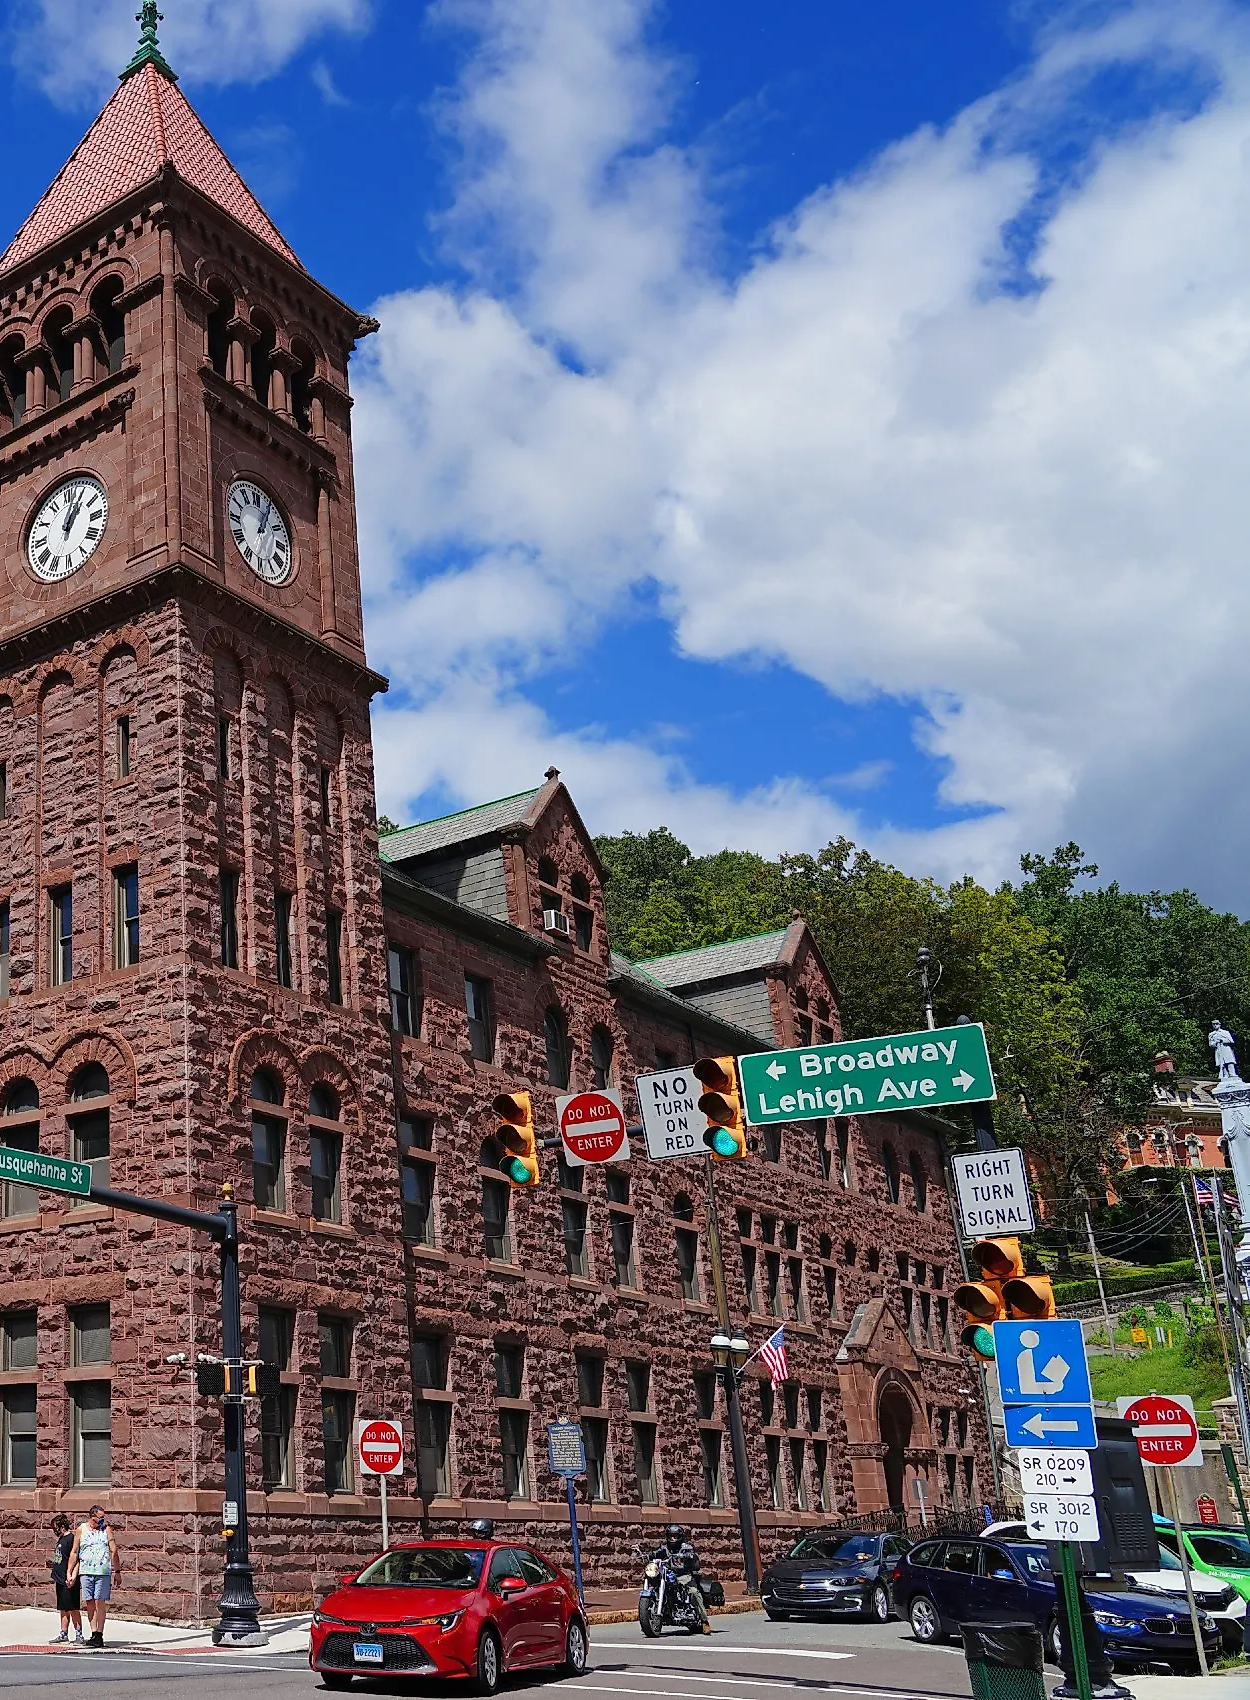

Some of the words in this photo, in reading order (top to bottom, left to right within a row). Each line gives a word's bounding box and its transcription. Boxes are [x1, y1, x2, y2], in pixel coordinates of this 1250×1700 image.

[799, 1039, 958, 1077] Broadway
[652, 1077, 688, 1099] NO
[759, 1083, 864, 1114] Lehigh
[877, 1077, 937, 1102] Ave
[568, 1108, 583, 1121] DO
[590, 1104, 611, 1118] NOT
[654, 1098, 694, 1116] TURN
[666, 1117, 688, 1133] ON
[577, 1136, 613, 1151] ENTER
[665, 1134, 694, 1151] RED
[71, 1166, 83, 1184] St
[965, 1160, 1010, 1179] RIGHT
[971, 1183, 1014, 1202] TURN
[967, 1207, 1027, 1227] SIGNAL
[1131, 1410, 1149, 1421] DO
[1156, 1410, 1181, 1421] NOT
[366, 1431, 376, 1440] DO
[380, 1431, 395, 1440] NOT
[1141, 1440, 1183, 1451] ENTER
[370, 1454, 393, 1463] ENTER
[1023, 1458, 1041, 1470] SR
[1047, 1458, 1085, 1470] 0209
[1036, 1474, 1056, 1486] 210
[1030, 1502, 1048, 1514] SR
[1058, 1503, 1091, 1516] 3012
[1055, 1520, 1079, 1534] 170
